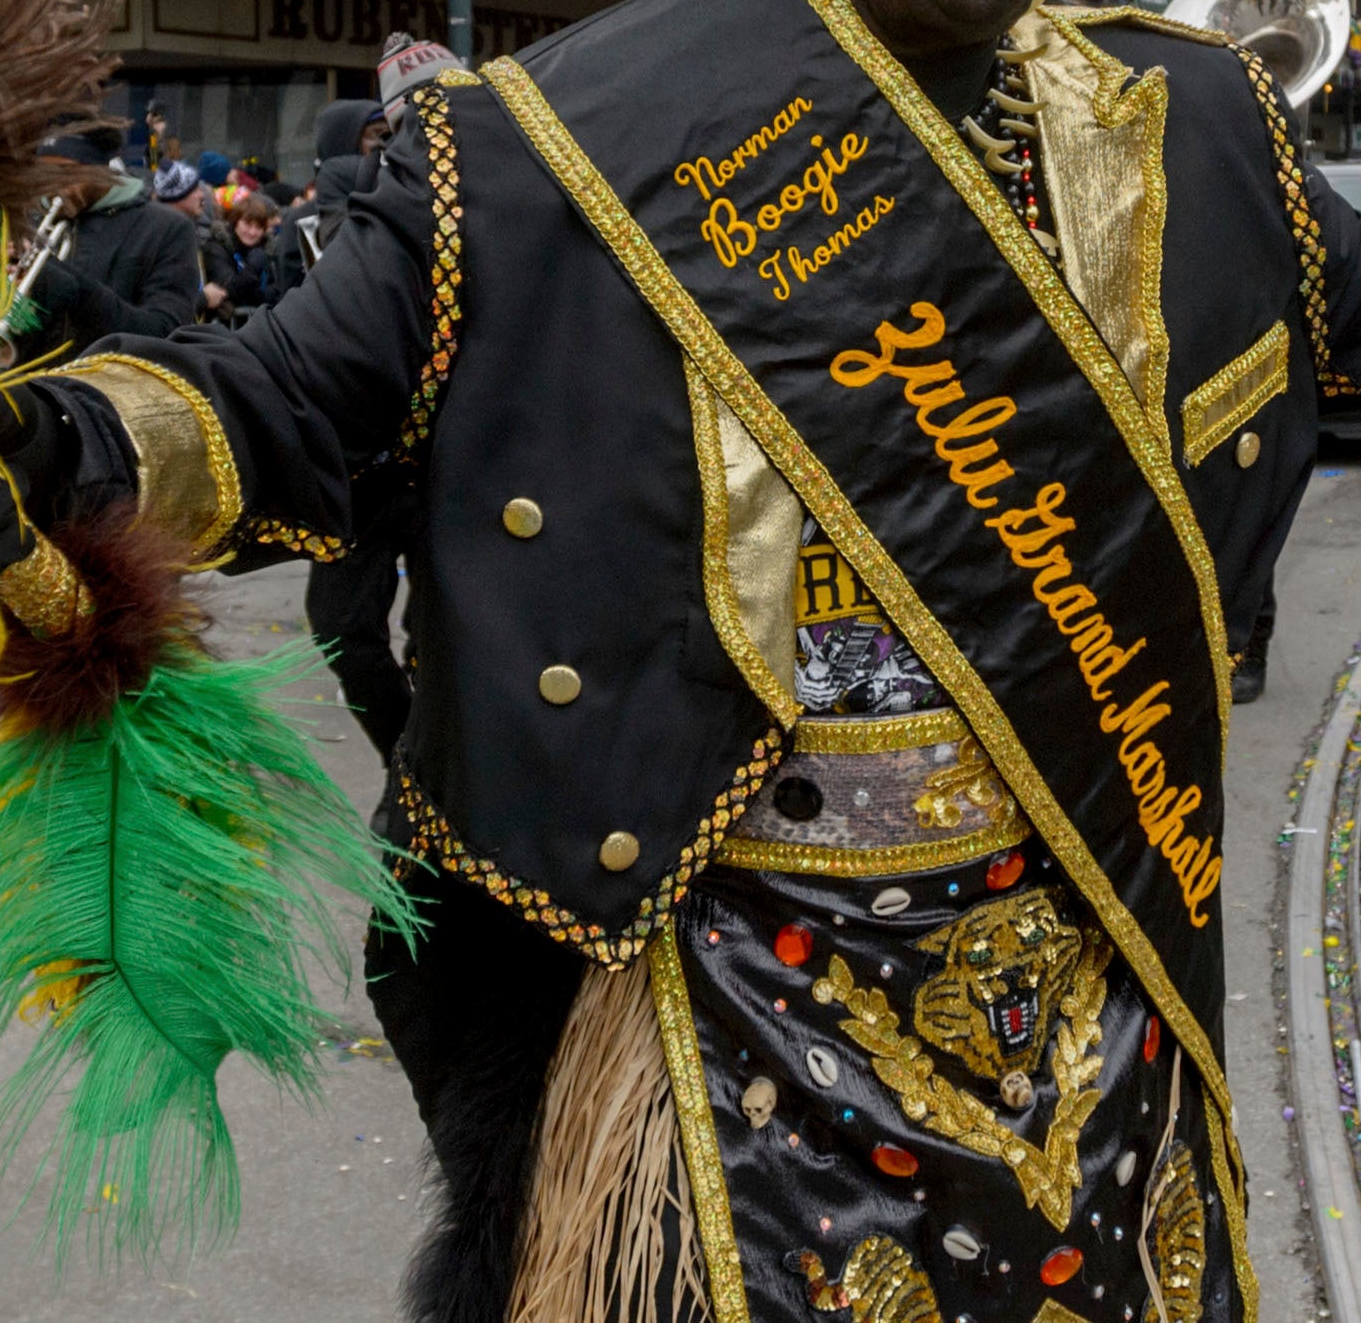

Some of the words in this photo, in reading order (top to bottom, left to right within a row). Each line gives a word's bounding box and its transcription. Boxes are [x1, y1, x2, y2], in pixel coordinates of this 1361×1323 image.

[674, 92, 813, 201] Norman
[700, 128, 870, 268] Boogie
[758, 191, 896, 301] Thomas
[829, 301, 1018, 510] Zulu
[986, 481, 1149, 702] Grand
[1099, 680, 1224, 929] Marshall
